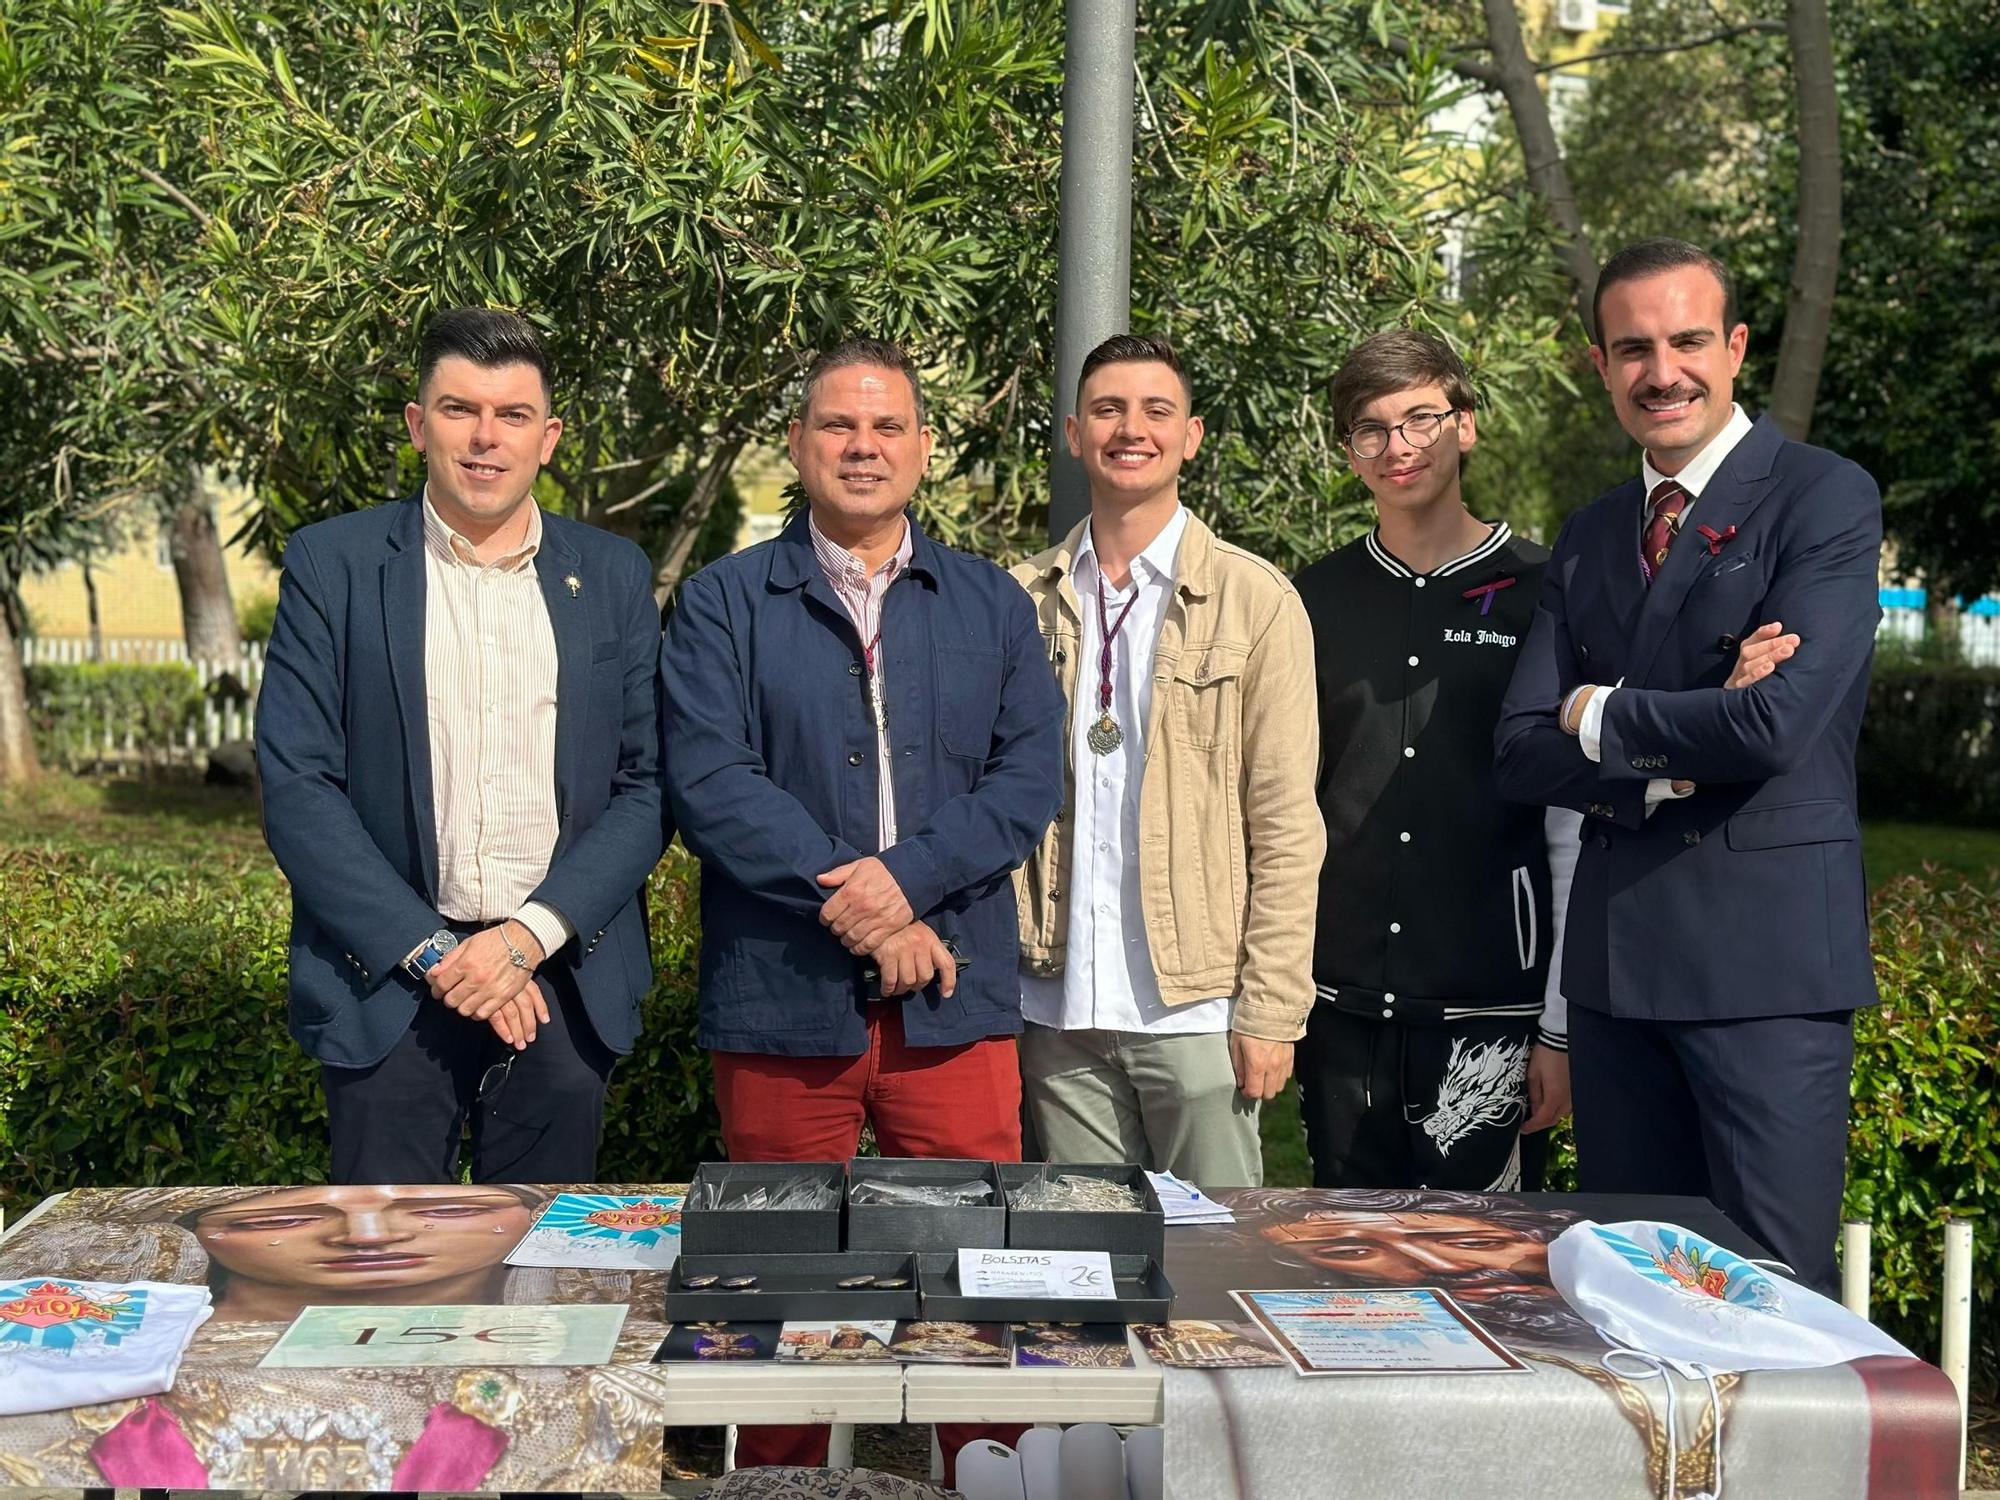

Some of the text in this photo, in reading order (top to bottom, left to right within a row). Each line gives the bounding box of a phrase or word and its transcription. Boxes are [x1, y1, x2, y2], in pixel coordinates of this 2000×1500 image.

[1443, 628, 1517, 648] Lola Indigo
[980, 1253, 1052, 1266] BOLSITAS
[1068, 1265, 1104, 1287] 2€
[344, 1325, 552, 1346] 15€
